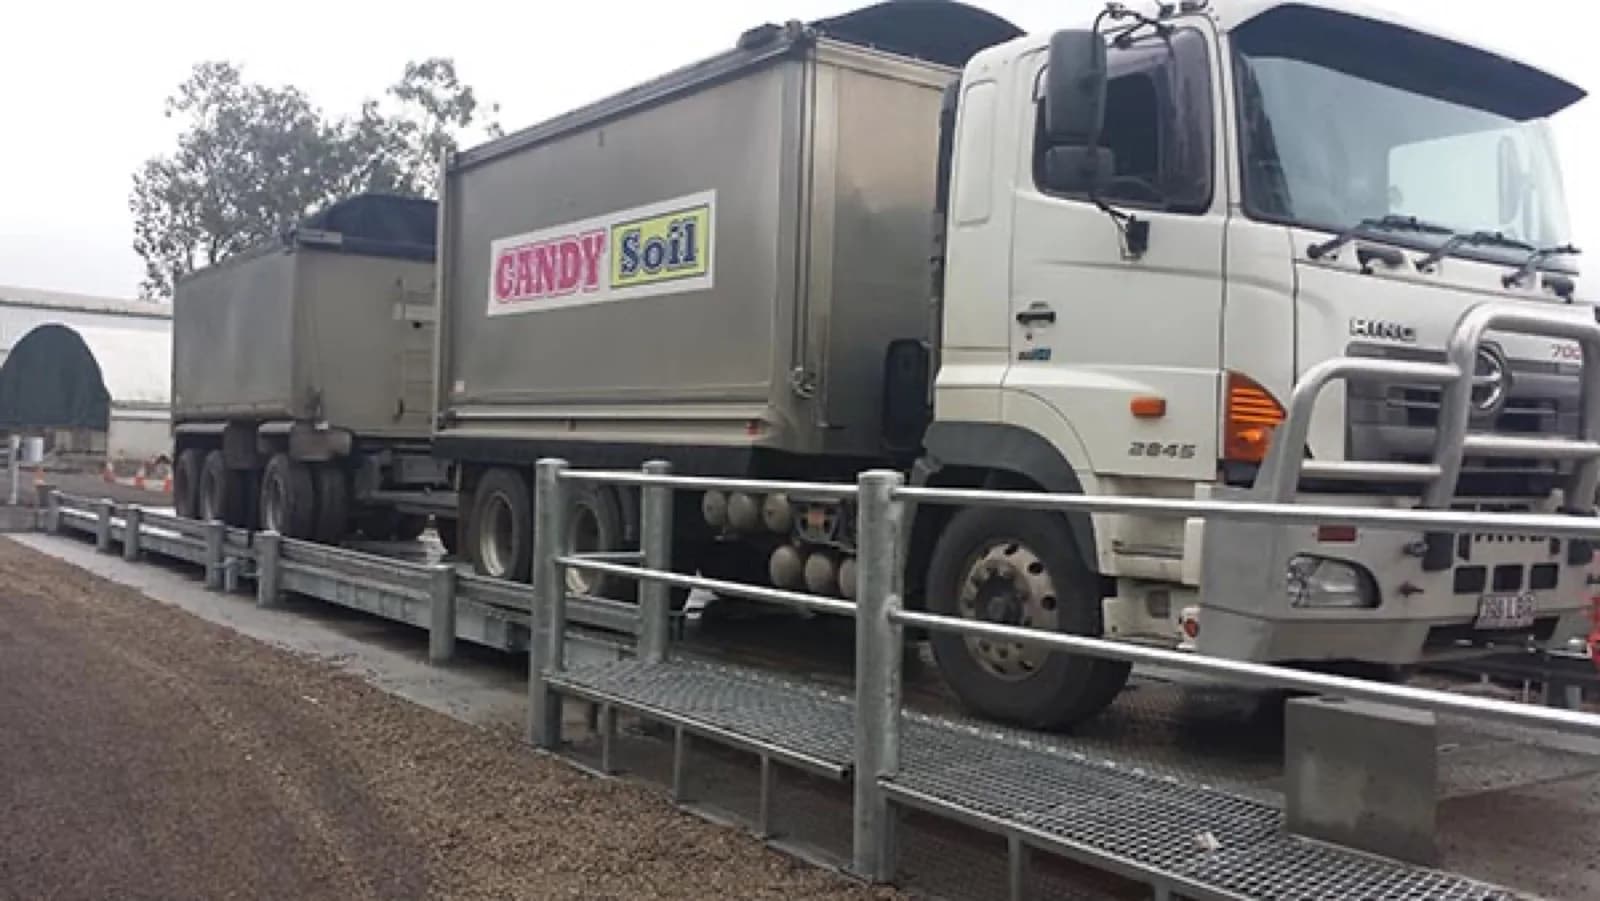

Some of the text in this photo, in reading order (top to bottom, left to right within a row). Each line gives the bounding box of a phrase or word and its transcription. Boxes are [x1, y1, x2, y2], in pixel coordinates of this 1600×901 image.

[495, 214, 698, 303] CANDY Soil
[1127, 441, 1197, 459] 2845
